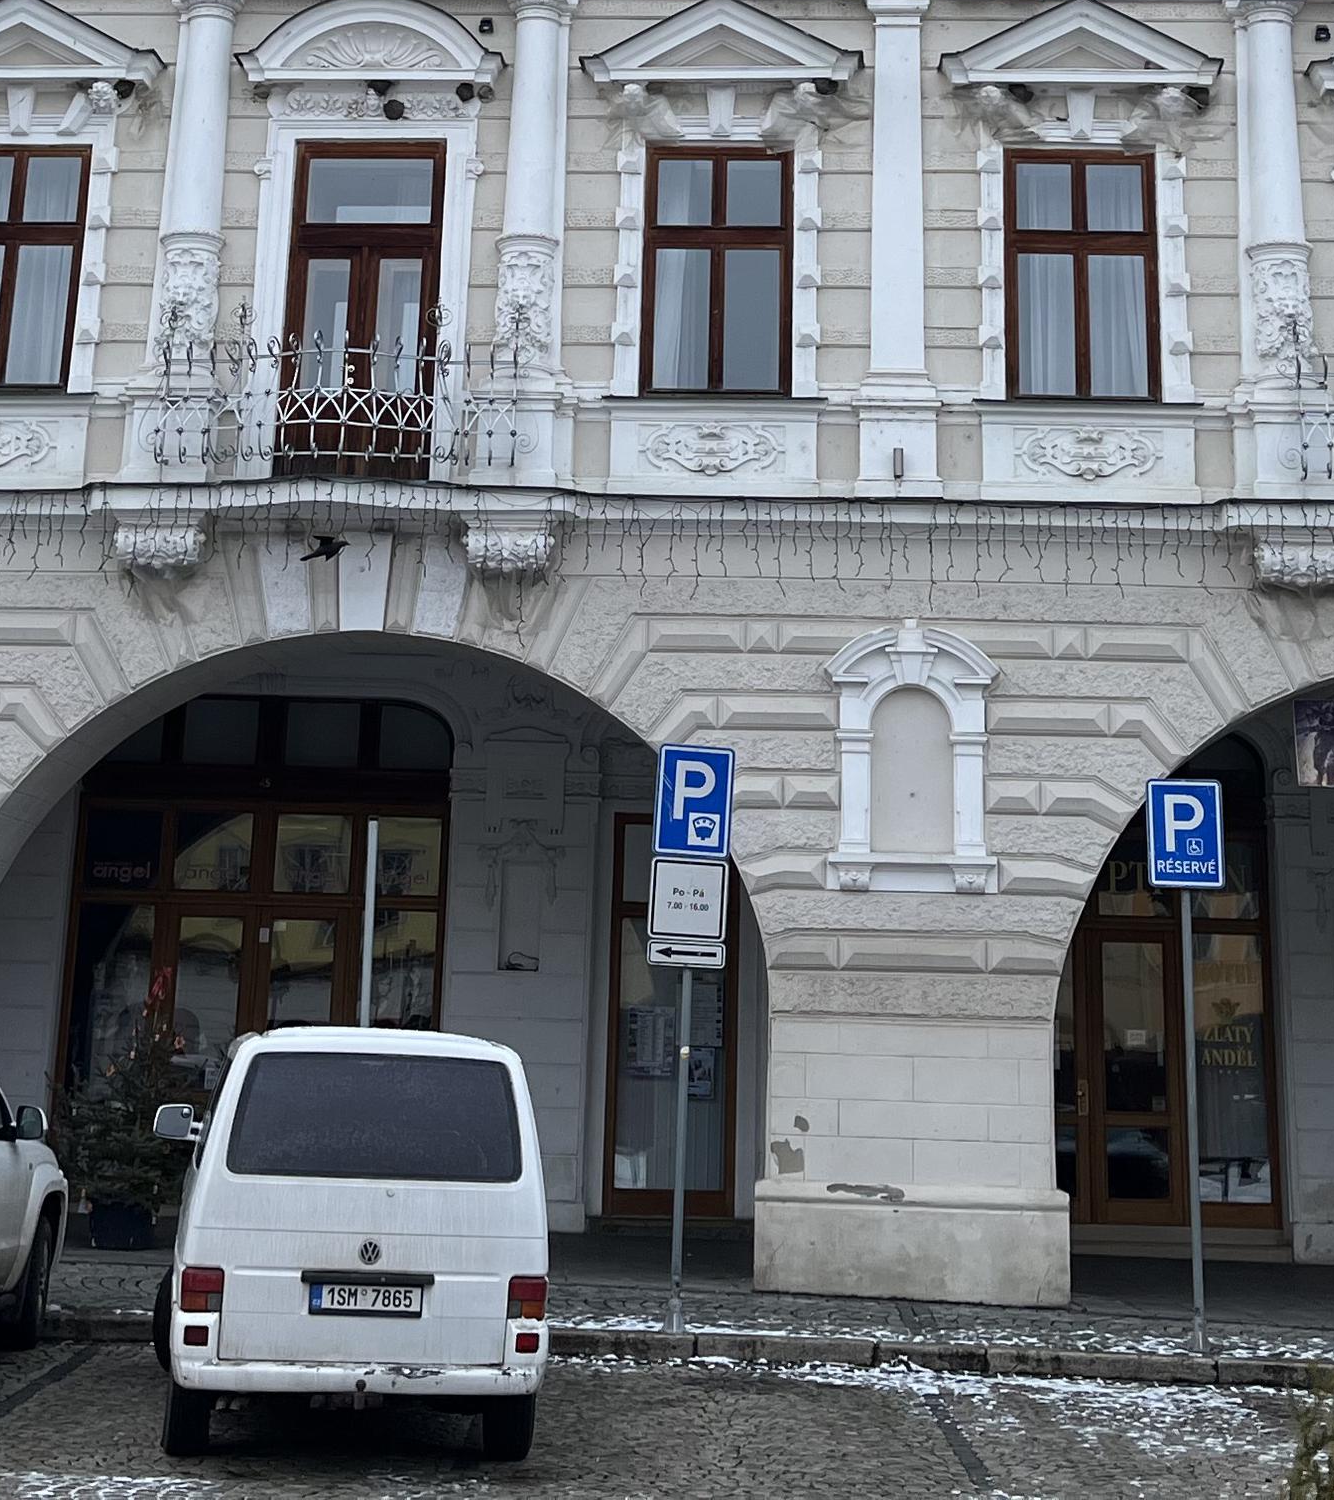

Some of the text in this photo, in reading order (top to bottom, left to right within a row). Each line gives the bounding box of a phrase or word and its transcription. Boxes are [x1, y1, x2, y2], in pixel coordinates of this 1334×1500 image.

[672, 759, 716, 820] P
[1165, 793, 1205, 853] P
[92, 861, 151, 883] angel
[1157, 856, 1217, 875] RÉSERVÉ
[672, 887, 685, 896] Po
[1201, 1045, 1257, 1067] ANDĚL
[327, 1286, 358, 1307] 1SM
[370, 1288, 414, 1308] 7865
